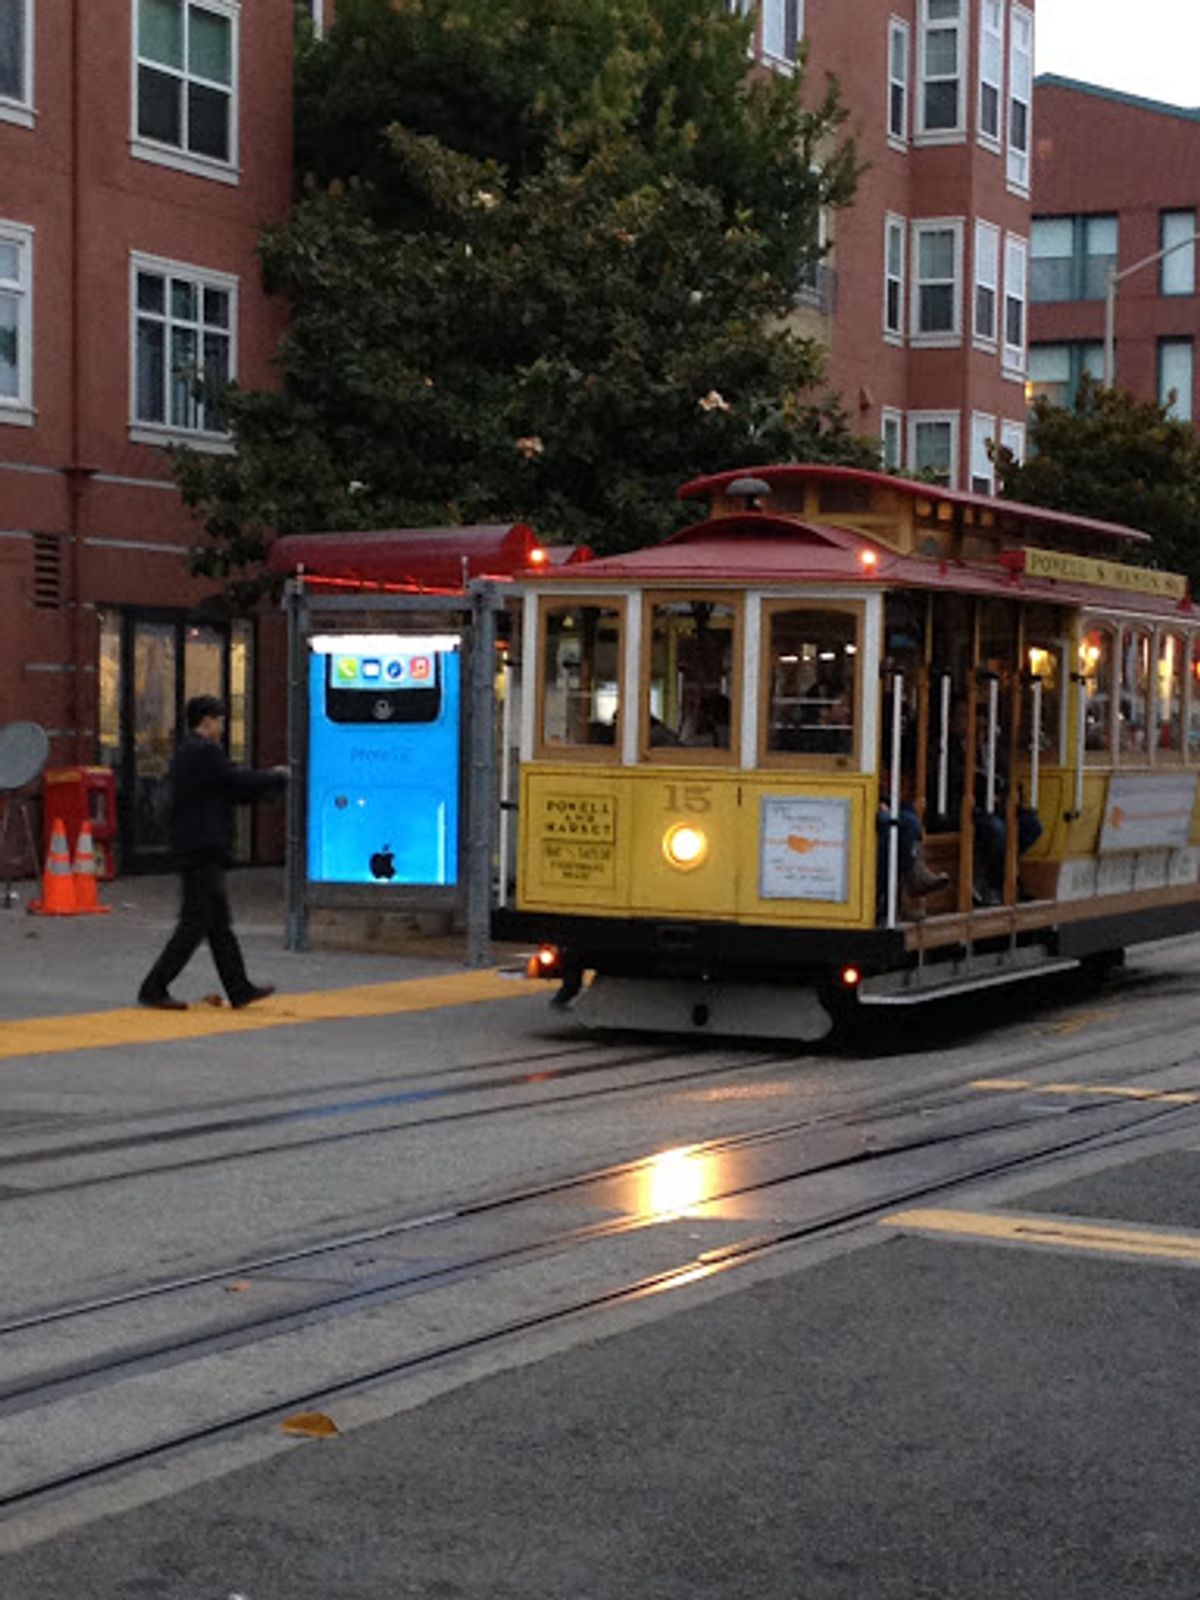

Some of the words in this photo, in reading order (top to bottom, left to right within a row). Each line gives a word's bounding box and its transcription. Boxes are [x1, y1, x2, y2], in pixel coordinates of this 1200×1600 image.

[662, 784, 713, 814] 15
[546, 800, 610, 814] POWELL
[546, 822, 611, 835] MARKET
